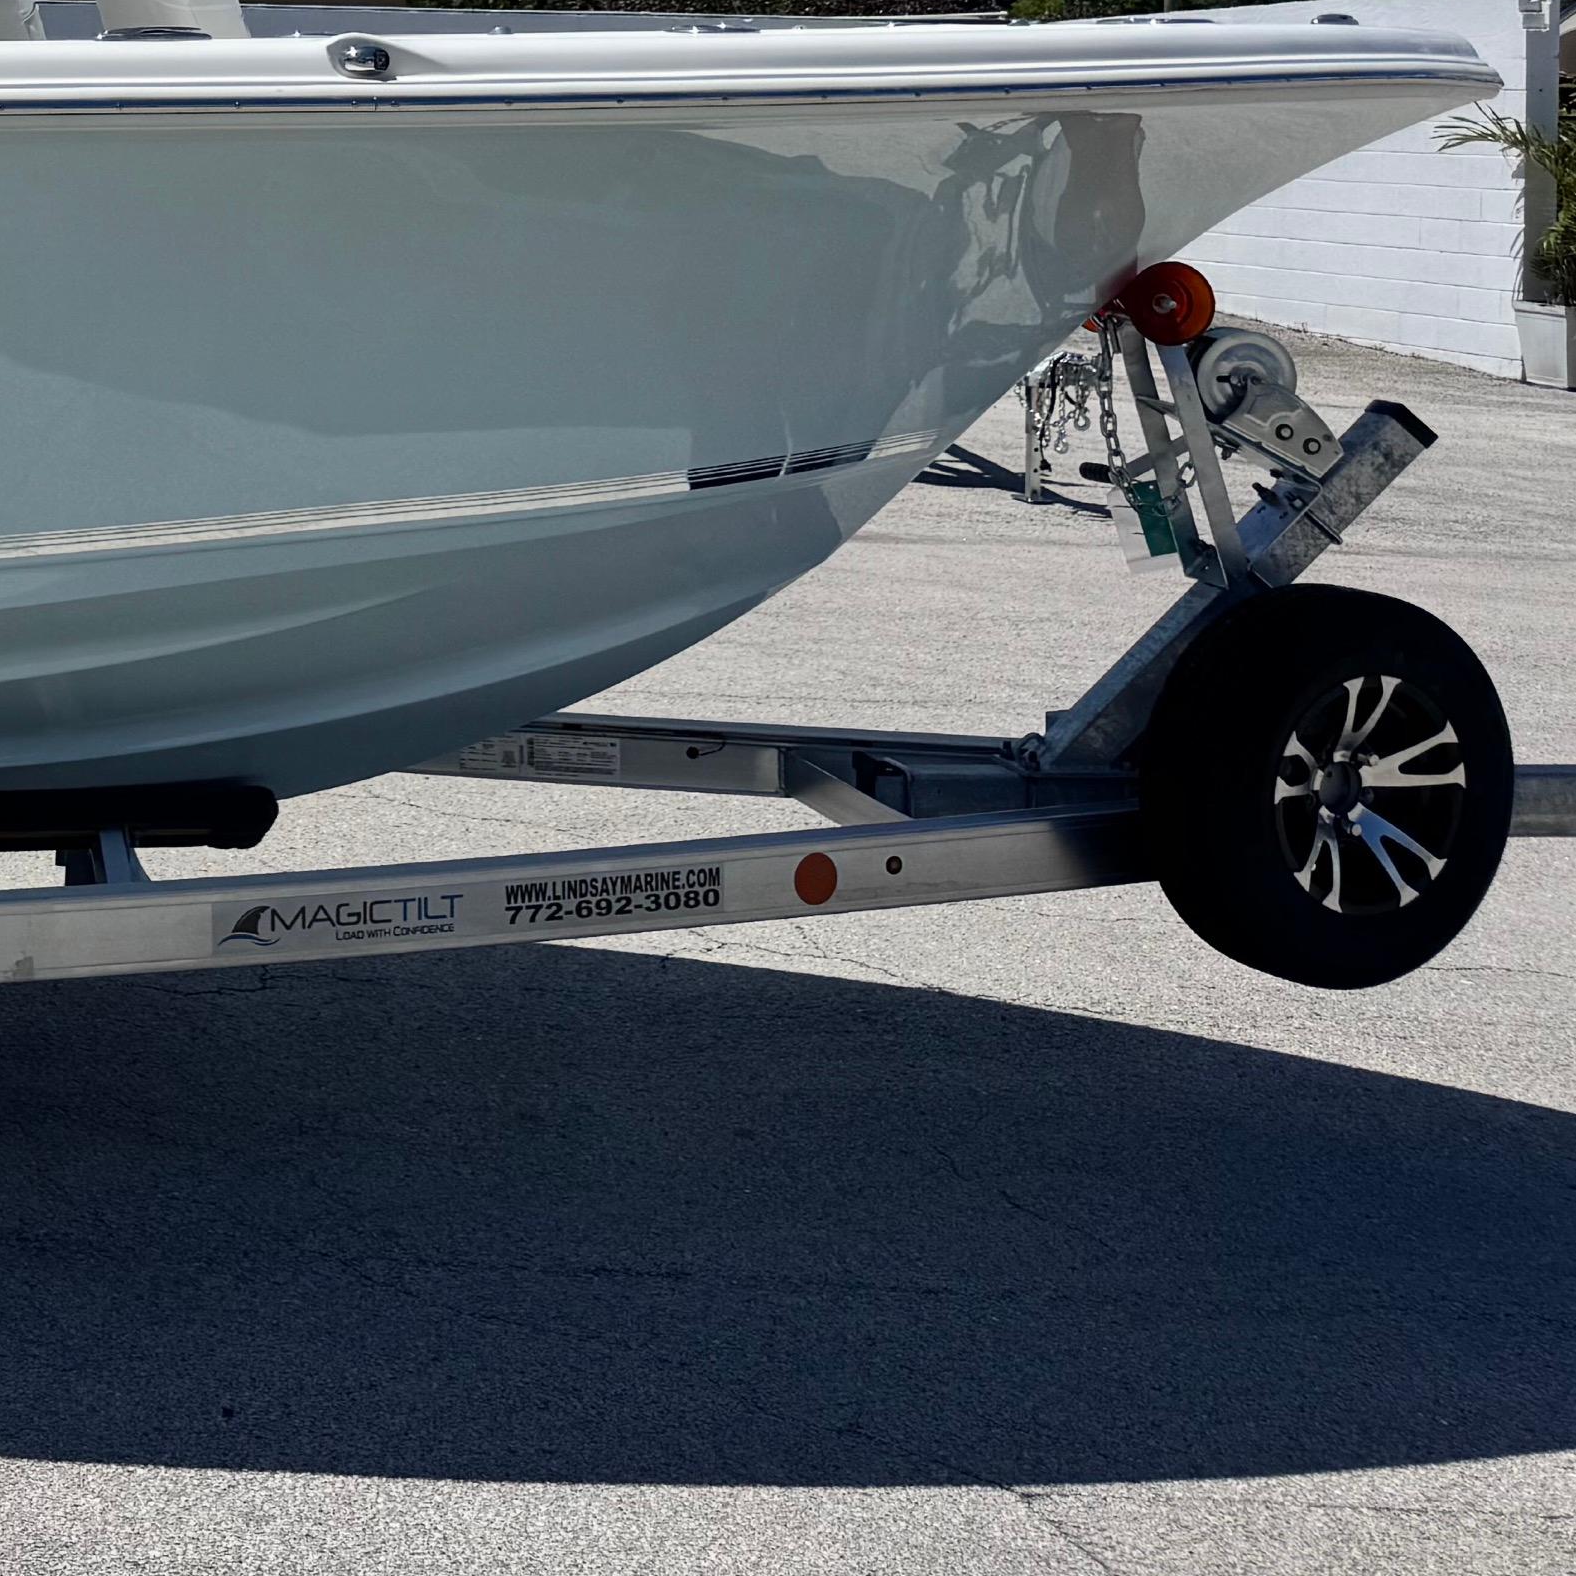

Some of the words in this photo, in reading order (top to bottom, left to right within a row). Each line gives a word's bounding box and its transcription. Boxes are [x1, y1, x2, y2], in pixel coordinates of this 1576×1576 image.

[505, 867, 720, 905] WWW.LINDSAYMARINE.COM
[270, 894, 464, 932] MAGICTILT
[505, 888, 720, 925] 772-692-3080
